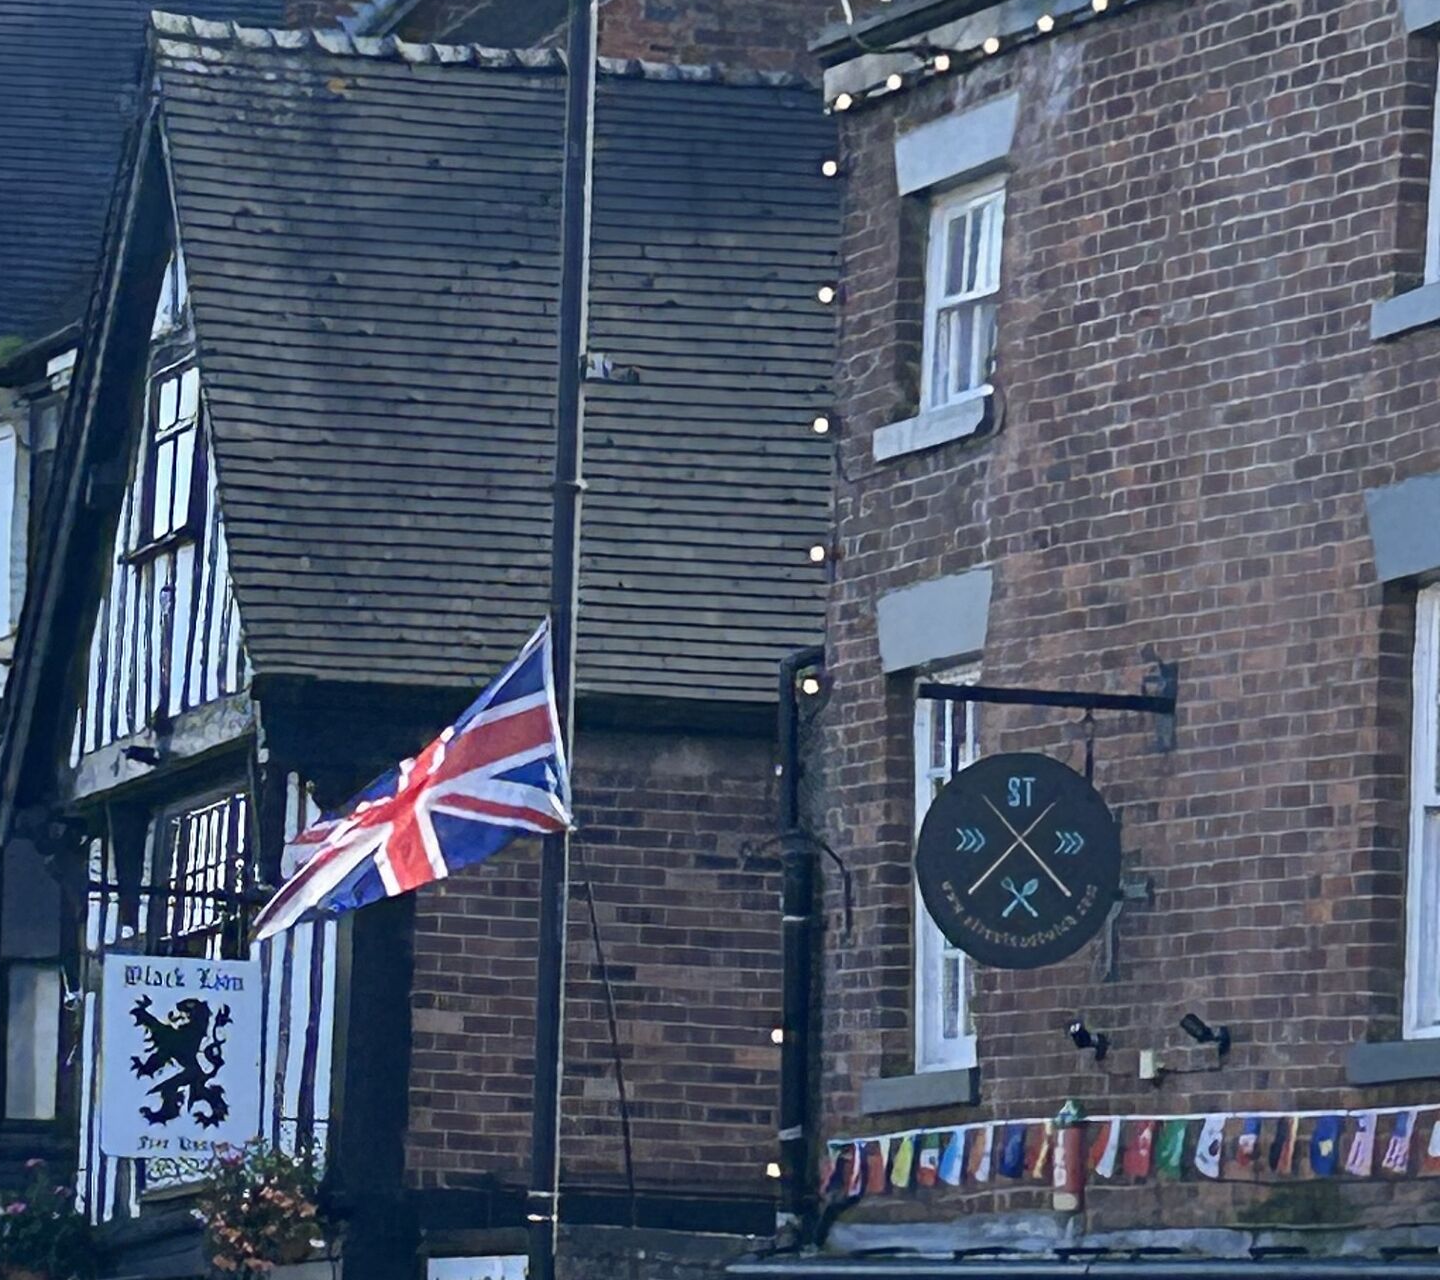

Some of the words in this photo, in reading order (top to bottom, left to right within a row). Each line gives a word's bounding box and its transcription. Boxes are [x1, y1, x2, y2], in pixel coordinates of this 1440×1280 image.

[1007, 776, 1036, 808] ST
[124, 965, 186, 990] Black
[198, 967, 246, 992] Lion
